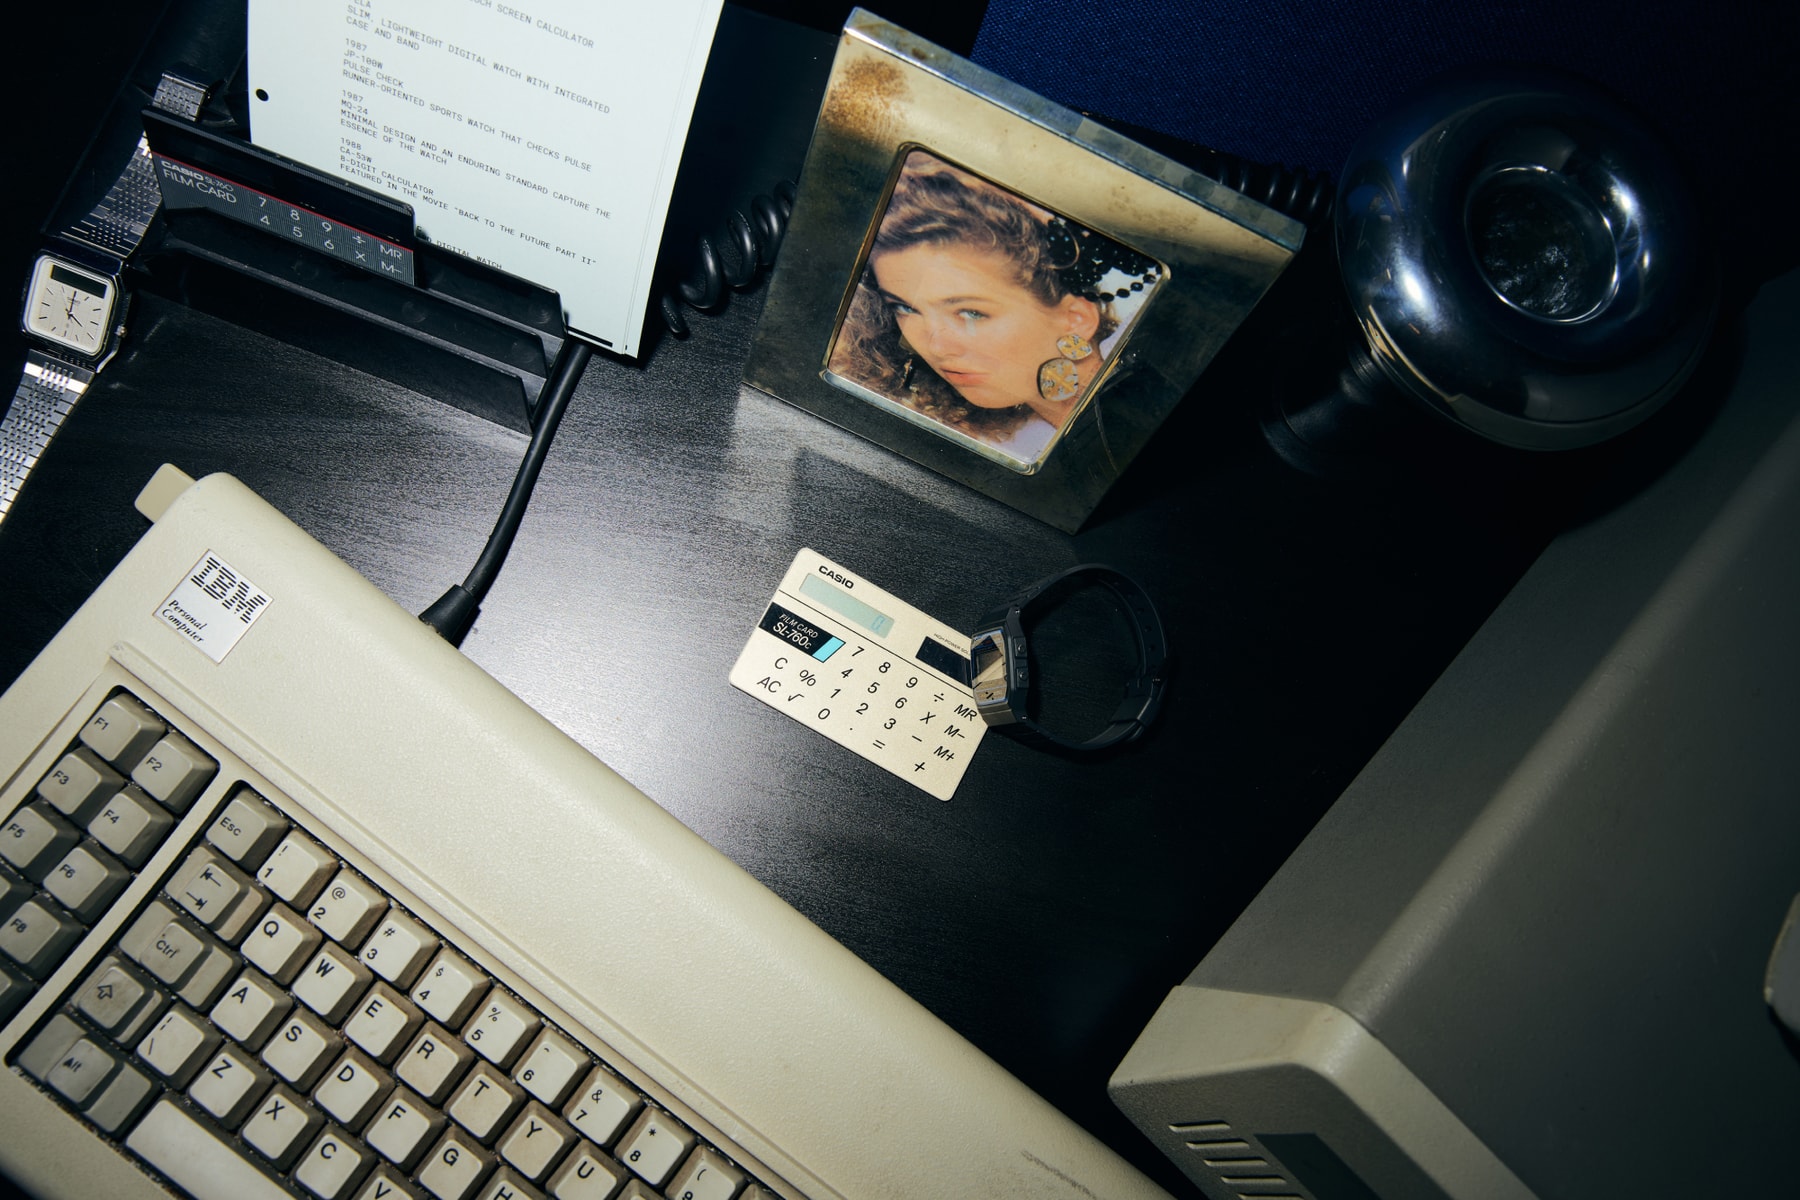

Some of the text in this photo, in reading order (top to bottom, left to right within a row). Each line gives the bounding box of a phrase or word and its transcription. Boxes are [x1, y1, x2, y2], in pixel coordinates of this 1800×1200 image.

[346, 16, 420, 51] CASE AND BAND
[497, 3, 594, 48] SCREEN CALCULATOR
[345, 38, 367, 52] 1987
[343, 58, 404, 88] PULSE CHECK
[381, 18, 443, 48] LIGHTWEIGHT
[448, 44, 487, 66] DIGITAL
[493, 62, 522, 79] WATCH
[526, 75, 549, 90] WITH
[554, 86, 610, 114] INTEGRATED
[342, 90, 364, 103] 1987
[341, 99, 368, 115] MQ-24
[343, 69, 592, 173] RUNNER-ORIENTED SPORTS WATCH THAT CHECKS PULSE
[340, 118, 447, 165] ESSENCE OF THE WATCH
[340, 137, 362, 151] 1988
[161, 160, 204, 181] CASIO
[341, 109, 611, 220] MINIMAL DESIGN AND AN ENDURING STANDARD CAPTURE THE
[163, 169, 237, 203] FILM CARD
[381, 170, 434, 196] CALCULATOR
[340, 163, 382, 184] FEATURED
[387, 181, 398, 191] IN
[402, 187, 418, 198] THE
[422, 195, 449, 210] MOVIE
[484, 219, 495, 228] TO
[500, 225, 515, 236] THE
[520, 232, 551, 249] FUTURE
[555, 246, 576, 260] PART
[258, 197, 267, 208] 7
[290, 209, 300, 221] 8
[321, 222, 332, 233] 9
[379, 244, 402, 260] MR
[260, 215, 270, 225] 4
[292, 227, 303, 239] 5
[324, 239, 334, 250] 6
[818, 565, 854, 590] CASIO
[190, 557, 267, 624] IBM
[168, 599, 208, 630] Personal
[162, 608, 204, 643] Computer
[778, 613, 819, 639] FILM CARD
[840, 668, 853, 679] 4
[867, 682, 880, 694] 5
[895, 697, 908, 709] 6
[851, 646, 865, 657] 7
[878, 662, 891, 674] 8
[905, 677, 918, 689] 9
[953, 704, 978, 722] MR
[756, 676, 782, 693] AC
[817, 708, 831, 720] 0
[774, 657, 788, 670] C
[830, 688, 841, 699] 1
[856, 702, 869, 715] 2
[884, 717, 897, 730] 3
[933, 745, 955, 761] M+
[93, 717, 109, 731] F1
[146, 756, 162, 772] F2
[52, 769, 69, 786] F3
[103, 809, 120, 824] F4
[7, 823, 25, 839] F5
[220, 816, 242, 837] Esc
[59, 864, 75, 879] F6
[264, 868, 274, 879] 1
[331, 887, 346, 900] @
[313, 907, 327, 920] 2
[10, 918, 27, 933] F8
[263, 920, 279, 938] Q
[382, 927, 396, 937] #
[156, 939, 179, 959] Ctrl
[367, 948, 378, 960] 3
[315, 958, 334, 978] W
[232, 985, 249, 1004] A
[419, 990, 431, 1000] 4
[365, 999, 383, 1018] E
[487, 1007, 501, 1022] %
[285, 1025, 302, 1043] S
[471, 1029, 484, 1041] 5
[416, 1039, 435, 1059] R
[62, 1057, 83, 1073] Alt
[211, 1059, 232, 1079] Z
[337, 1064, 354, 1082] D
[523, 1069, 534, 1081] 6
[473, 1080, 490, 1097] T
[591, 1089, 604, 1104] &
[265, 1100, 285, 1120] X
[388, 1104, 407, 1123] F
[576, 1109, 588, 1122] 7
[525, 1121, 543, 1139] Y
[320, 1142, 337, 1160] C
[442, 1148, 459, 1167] G
[629, 1150, 641, 1162] 8
[577, 1161, 595, 1179] U
[373, 1181, 391, 1200] V
